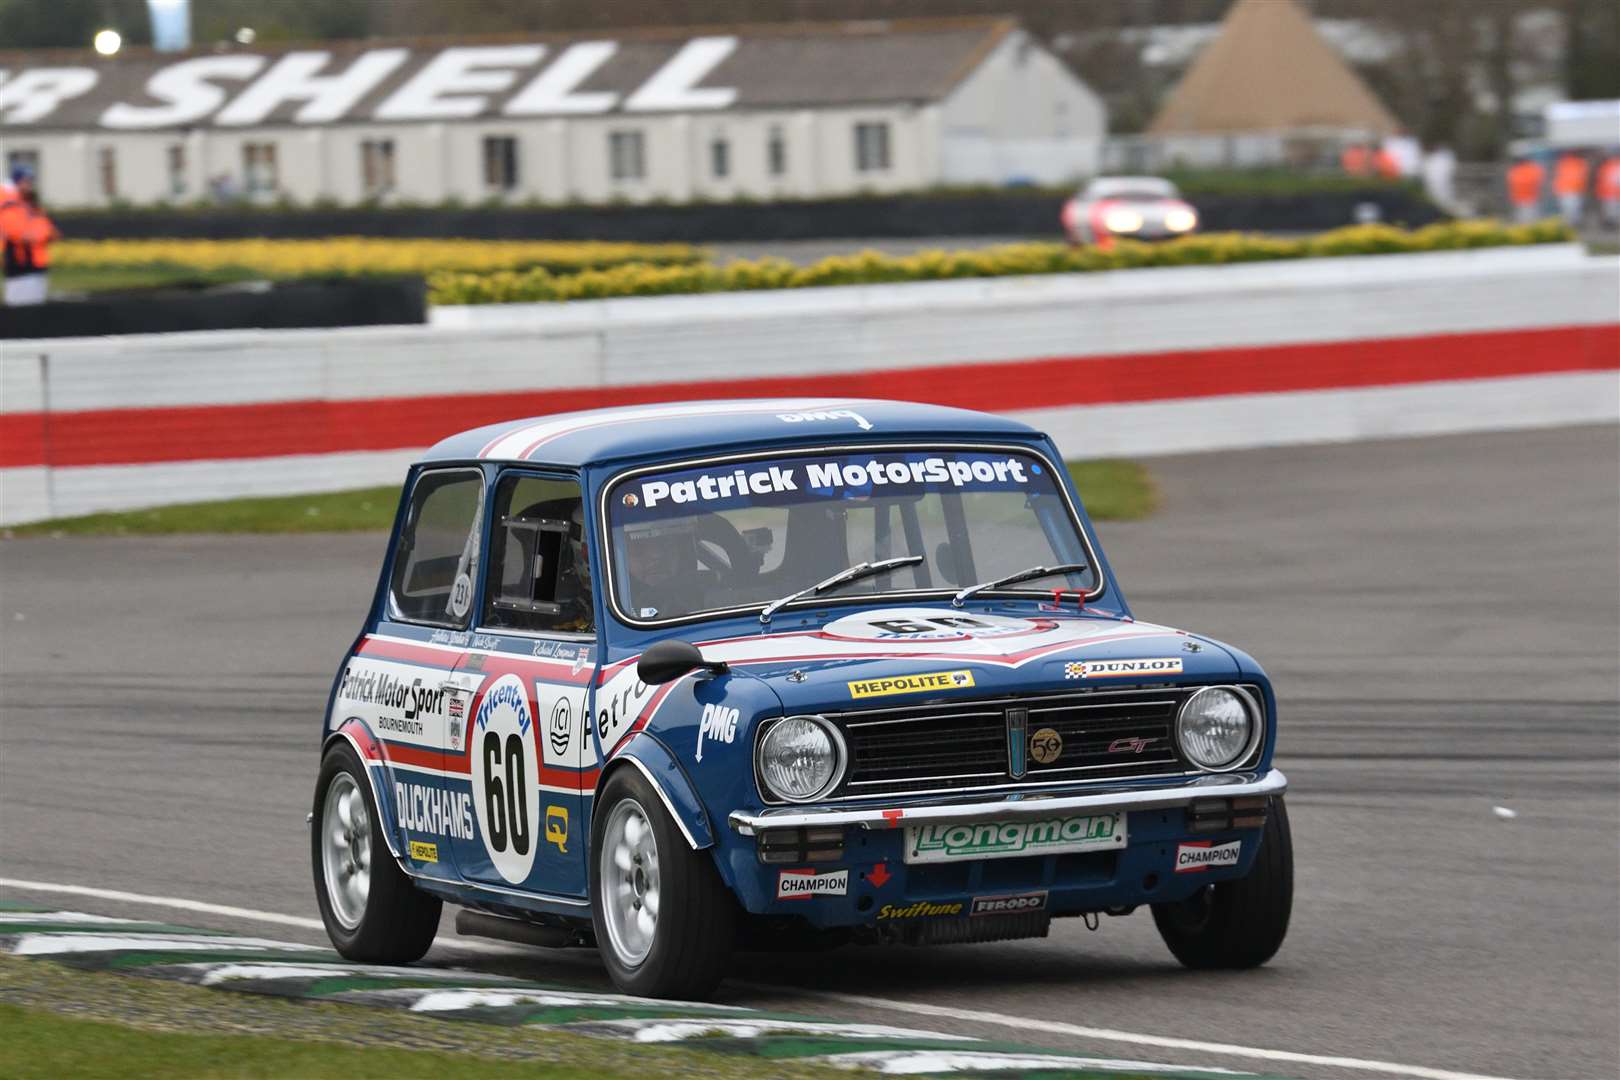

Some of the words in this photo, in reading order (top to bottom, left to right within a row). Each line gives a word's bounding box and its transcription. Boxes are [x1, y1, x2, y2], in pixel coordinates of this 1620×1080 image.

[101, 36, 739, 129] SHELL
[641, 466, 798, 508] Patrick
[806, 457, 1028, 489] MotorSport
[1091, 661, 1180, 672] DUNLOP
[339, 667, 378, 703] Patrick
[854, 675, 950, 694] HEPOLITE
[477, 684, 531, 737] Tricentrol
[554, 708, 569, 731] ICI
[379, 716, 424, 736] BOURNEMOUTH
[695, 702, 740, 763] PMG
[1108, 736, 1160, 753] GT
[483, 731, 530, 855] 60
[394, 782, 474, 840] DUCKHAMS
[918, 815, 1114, 851] Longman
[1179, 848, 1239, 864] CHAMPION
[781, 878, 846, 891] CHAMPION
[877, 901, 963, 920] Swiftune
[977, 897, 1040, 912] FERODO
